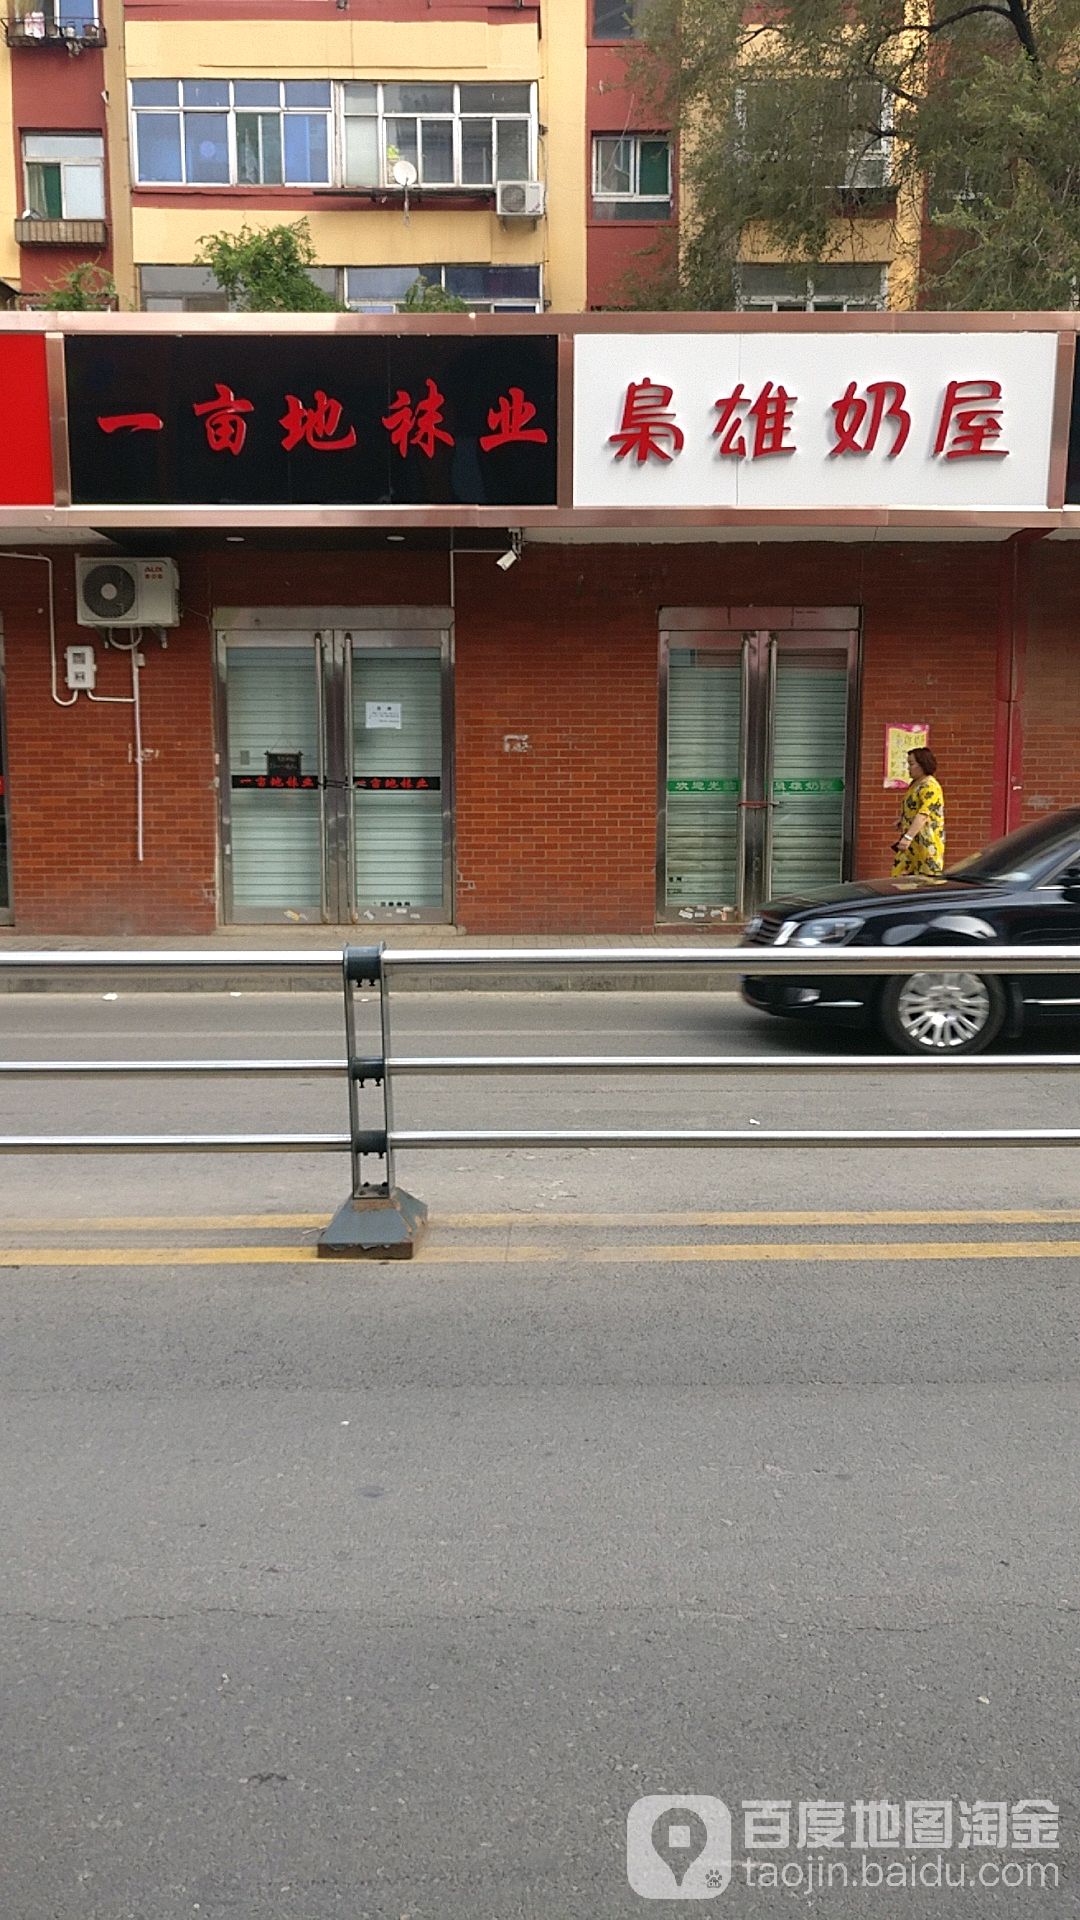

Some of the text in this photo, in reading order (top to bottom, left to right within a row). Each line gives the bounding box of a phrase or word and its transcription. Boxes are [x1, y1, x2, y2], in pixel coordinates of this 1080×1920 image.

[97, 378, 548, 459] 一亩地袜业
